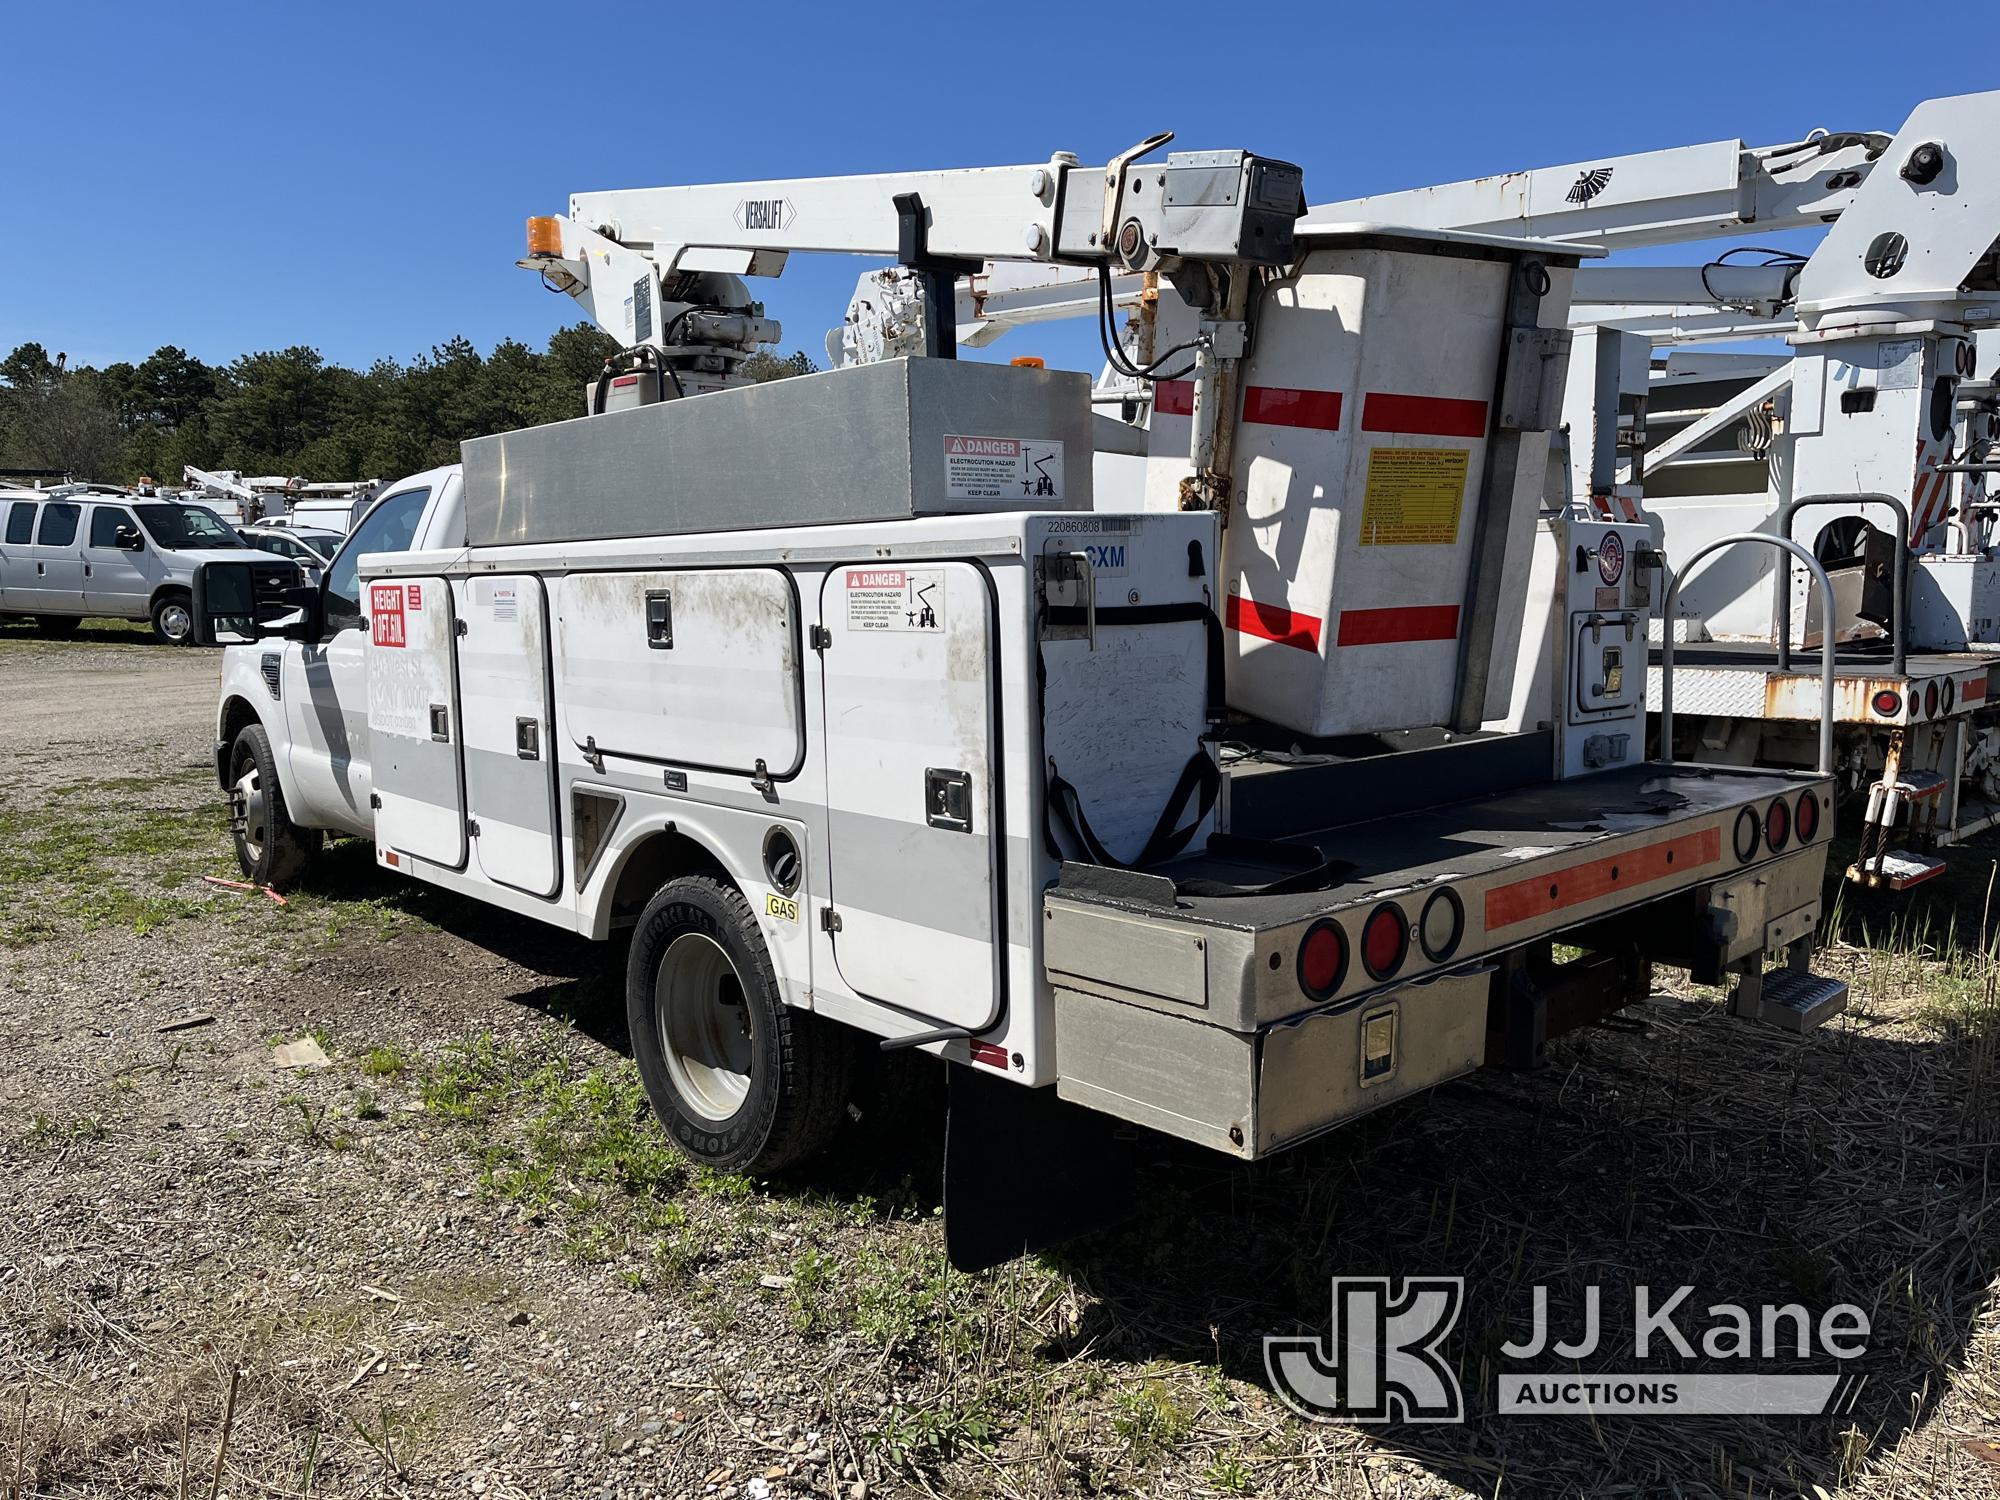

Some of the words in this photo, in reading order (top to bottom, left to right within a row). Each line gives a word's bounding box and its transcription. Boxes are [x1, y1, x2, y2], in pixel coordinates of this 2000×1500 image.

[746, 199, 783, 229] VERSALIFT
[967, 440, 1015, 454] DANGER
[950, 458, 994, 466] ELECTROCUTION
[1048, 521, 1100, 533] 220860808
[863, 573, 901, 586] DANGER
[374, 590, 400, 610] HEIGHT
[770, 898, 795, 920] GAS
